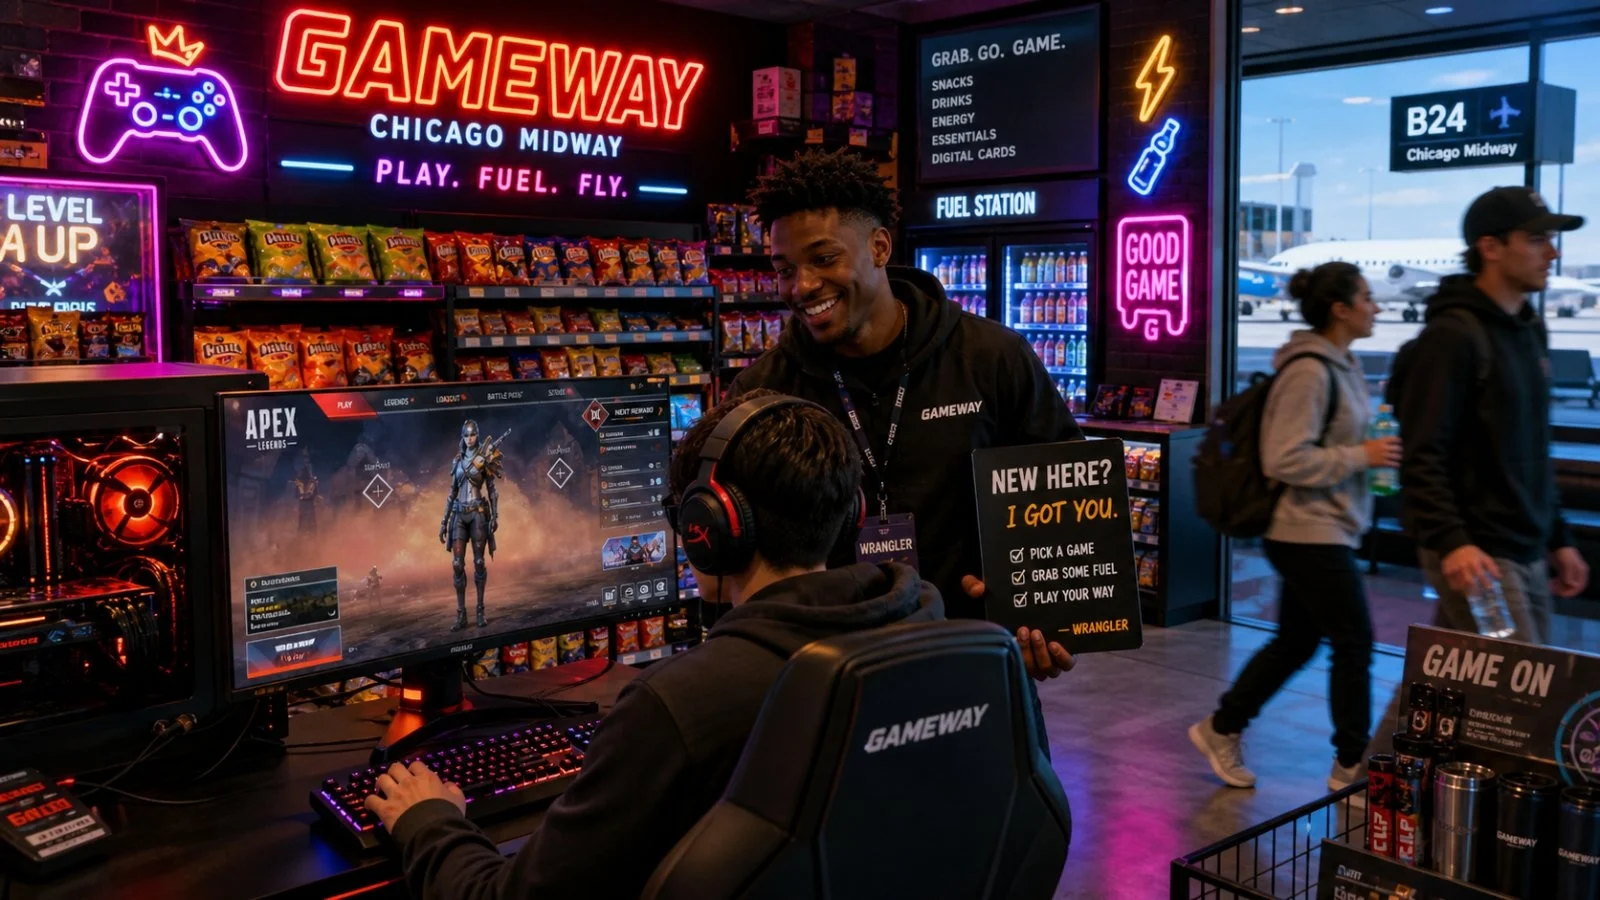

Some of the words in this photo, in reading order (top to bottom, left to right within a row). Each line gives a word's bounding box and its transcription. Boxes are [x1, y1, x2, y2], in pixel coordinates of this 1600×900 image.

[931, 48, 974, 68] GRAB.
[977, 43, 1005, 61] GO.
[1012, 33, 1066, 56] GAME.
[275, 8, 704, 131] GAMEWAY
[931, 75, 974, 92] SNACKS
[931, 94, 973, 110] DRINKS
[931, 112, 975, 128] ENERGY
[1406, 101, 1468, 137] B24
[370, 113, 503, 148] CHICAGO
[519, 127, 622, 158] MIDWAY
[931, 128, 997, 146] ESSENTIALS
[931, 150, 974, 165] DIGITAL
[977, 145, 1016, 161] CARDS
[1406, 146, 1460, 162] Chicago
[1463, 142, 1518, 158] Midway
[375, 158, 459, 188] PLAY.
[478, 165, 558, 194] FUEL.
[578, 173, 628, 198] FLY.
[7, 193, 103, 225] LEVEL
[936, 195, 971, 219] FUEL
[974, 191, 1036, 217] STATION
[36, 224, 98, 264] UP
[1125, 231, 1180, 265] GOOD
[1125, 268, 1180, 301] GAME
[1144, 318, 1159, 341] G
[336, 400, 353, 410] PLAY
[383, 397, 410, 407] LEGENDS
[920, 400, 983, 421] GAMEWAY
[245, 407, 298, 440] APEX
[257, 439, 287, 451] LEGENDS
[991, 465, 1039, 495] NEW
[1046, 458, 1113, 490] HERE?
[1006, 504, 1016, 529] I
[1023, 500, 1067, 527] GOT
[1074, 497, 1118, 523] YOU.
[859, 537, 913, 556] WRANGLER
[1030, 546, 1053, 560] PICK
[1056, 546, 1063, 558] A
[1066, 542, 1095, 557] GAME
[1031, 567, 1059, 582] GRAB
[1062, 565, 1090, 579] SOME
[1093, 562, 1117, 577] FUEL
[1034, 590, 1058, 605] PLAY
[1062, 588, 1089, 603] YOUR
[1091, 585, 1115, 600] WAY
[1072, 618, 1129, 635] WRANGLER
[1422, 644, 1504, 689] GAME
[1509, 659, 1555, 698] ON
[864, 703, 990, 754] GAMEWAY
[1496, 830, 1538, 848] GAMEWAY
[1557, 847, 1600, 865] GAMEWAY
